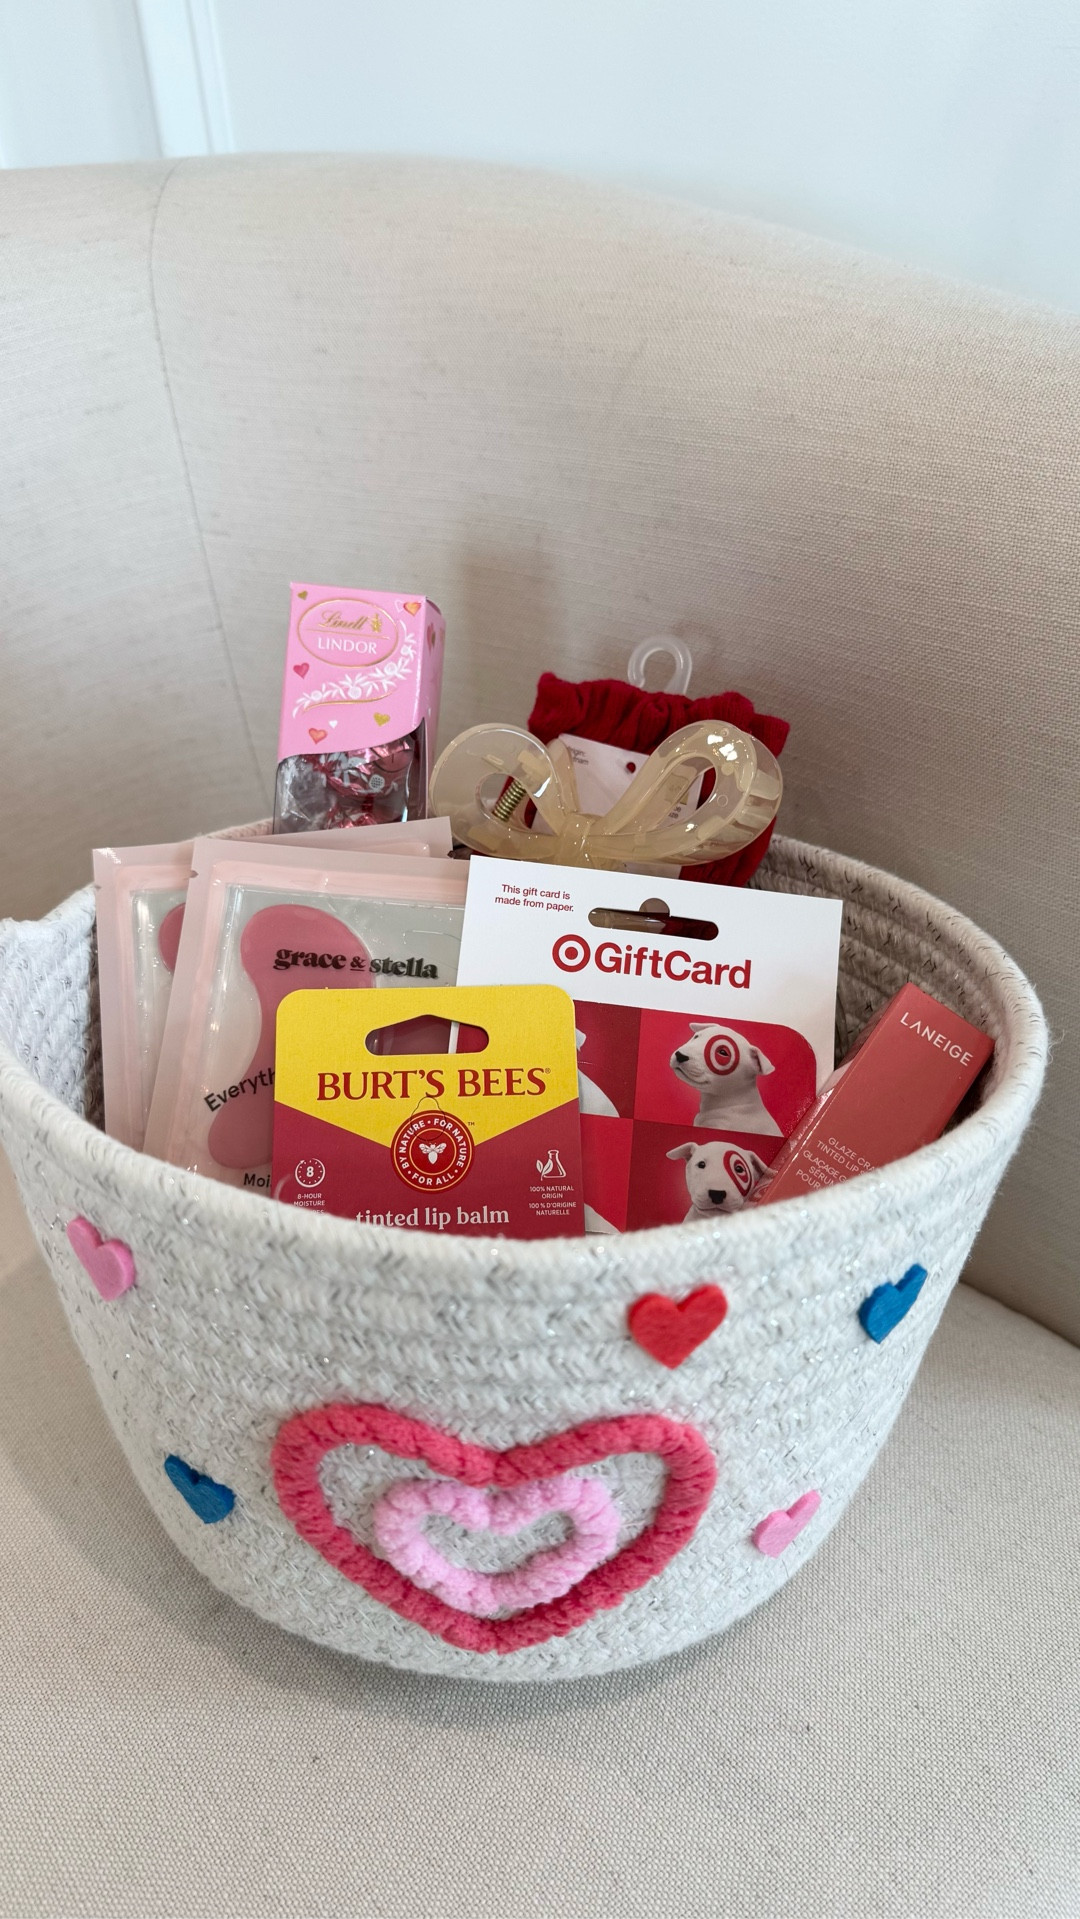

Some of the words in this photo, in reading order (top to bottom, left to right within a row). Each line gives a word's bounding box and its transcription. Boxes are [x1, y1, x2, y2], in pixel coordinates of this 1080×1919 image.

[318, 610, 368, 630] Lindt
[318, 637, 377, 655] LINDOR
[502, 884, 520, 894] This
[522, 887, 538, 897] gift
[540, 890, 561, 899] card
[562, 891, 571, 900] is
[494, 896, 521, 906] made
[523, 898, 544, 909] from
[546, 902, 574, 913] paper.
[273, 949, 347, 970] grace
[350, 956, 366, 971] &
[369, 956, 438, 979] stella
[594, 942, 752, 989] GiftCard
[900, 1011, 974, 1067] LANEIGE
[317, 1069, 445, 1101] BURT'S
[433, 1118, 453, 1131] FOR
[399, 1120, 426, 1153] NATURE
[452, 1128, 467, 1168] NATURE
[816, 1140, 845, 1164] TINTED
[845, 1161, 860, 1173] LIP
[828, 1137, 857, 1160] GLAZE
[306, 1166, 314, 1177] 8
[399, 1156, 410, 1170] BY
[243, 1173, 272, 1188] Moi
[411, 1172, 433, 1185] FOR
[436, 1172, 455, 1186] ALL
[796, 1169, 821, 1189] POUR
[356, 1208, 419, 1227] tinted
[425, 1207, 451, 1230] lip
[457, 1205, 510, 1225] balm
